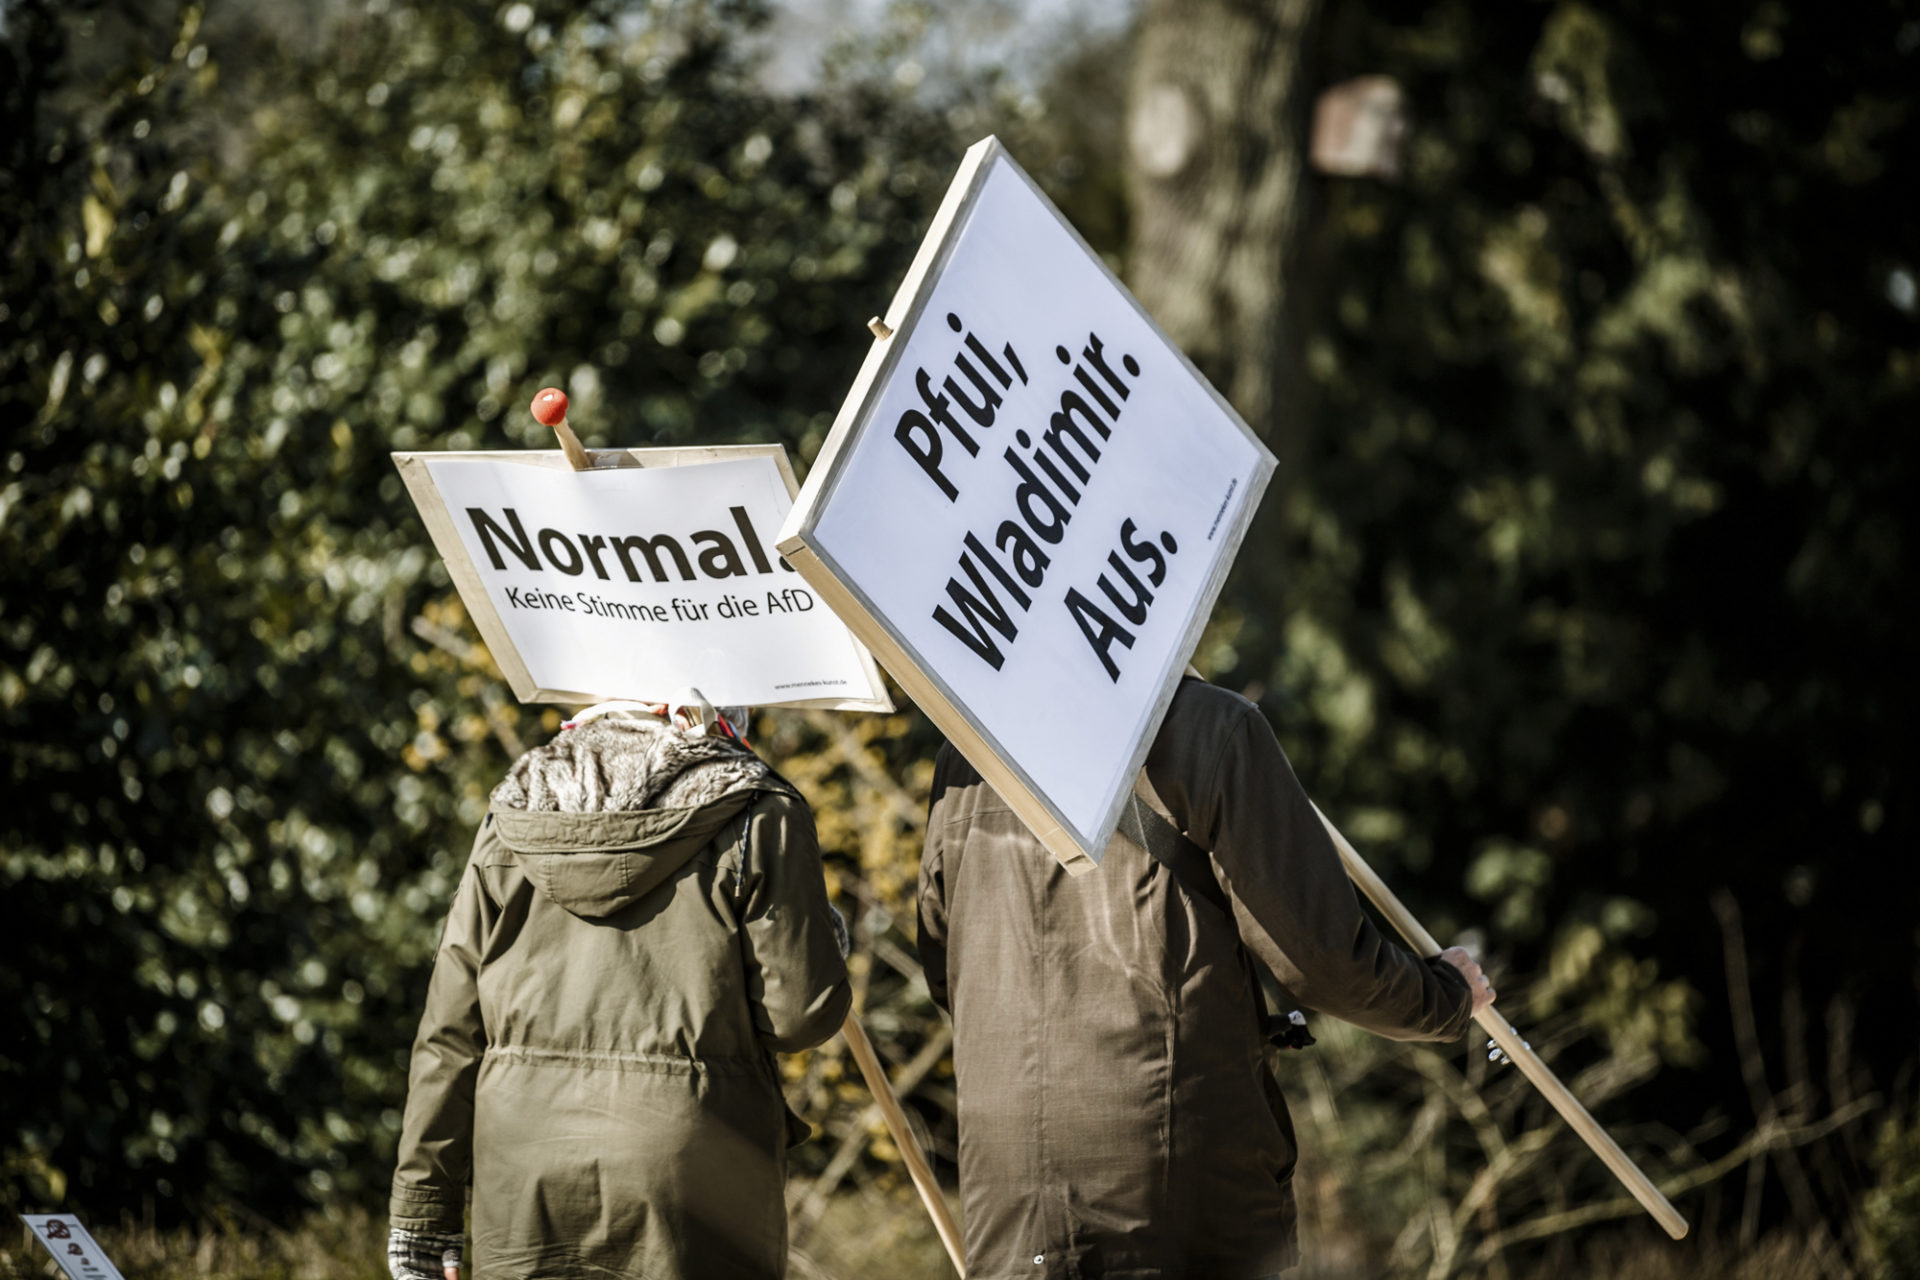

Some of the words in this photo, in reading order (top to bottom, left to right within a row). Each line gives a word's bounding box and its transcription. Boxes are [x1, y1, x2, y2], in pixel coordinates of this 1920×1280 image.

[893, 311, 1029, 504] Pfui,
[931, 331, 1141, 672] Wladimir.
[504, 586, 575, 612] Keine
[576, 592, 669, 623] Stimme
[671, 597, 709, 622] für
[716, 594, 760, 619] die
[766, 588, 814, 615] AfD
[1063, 517, 1178, 684] Aus.
